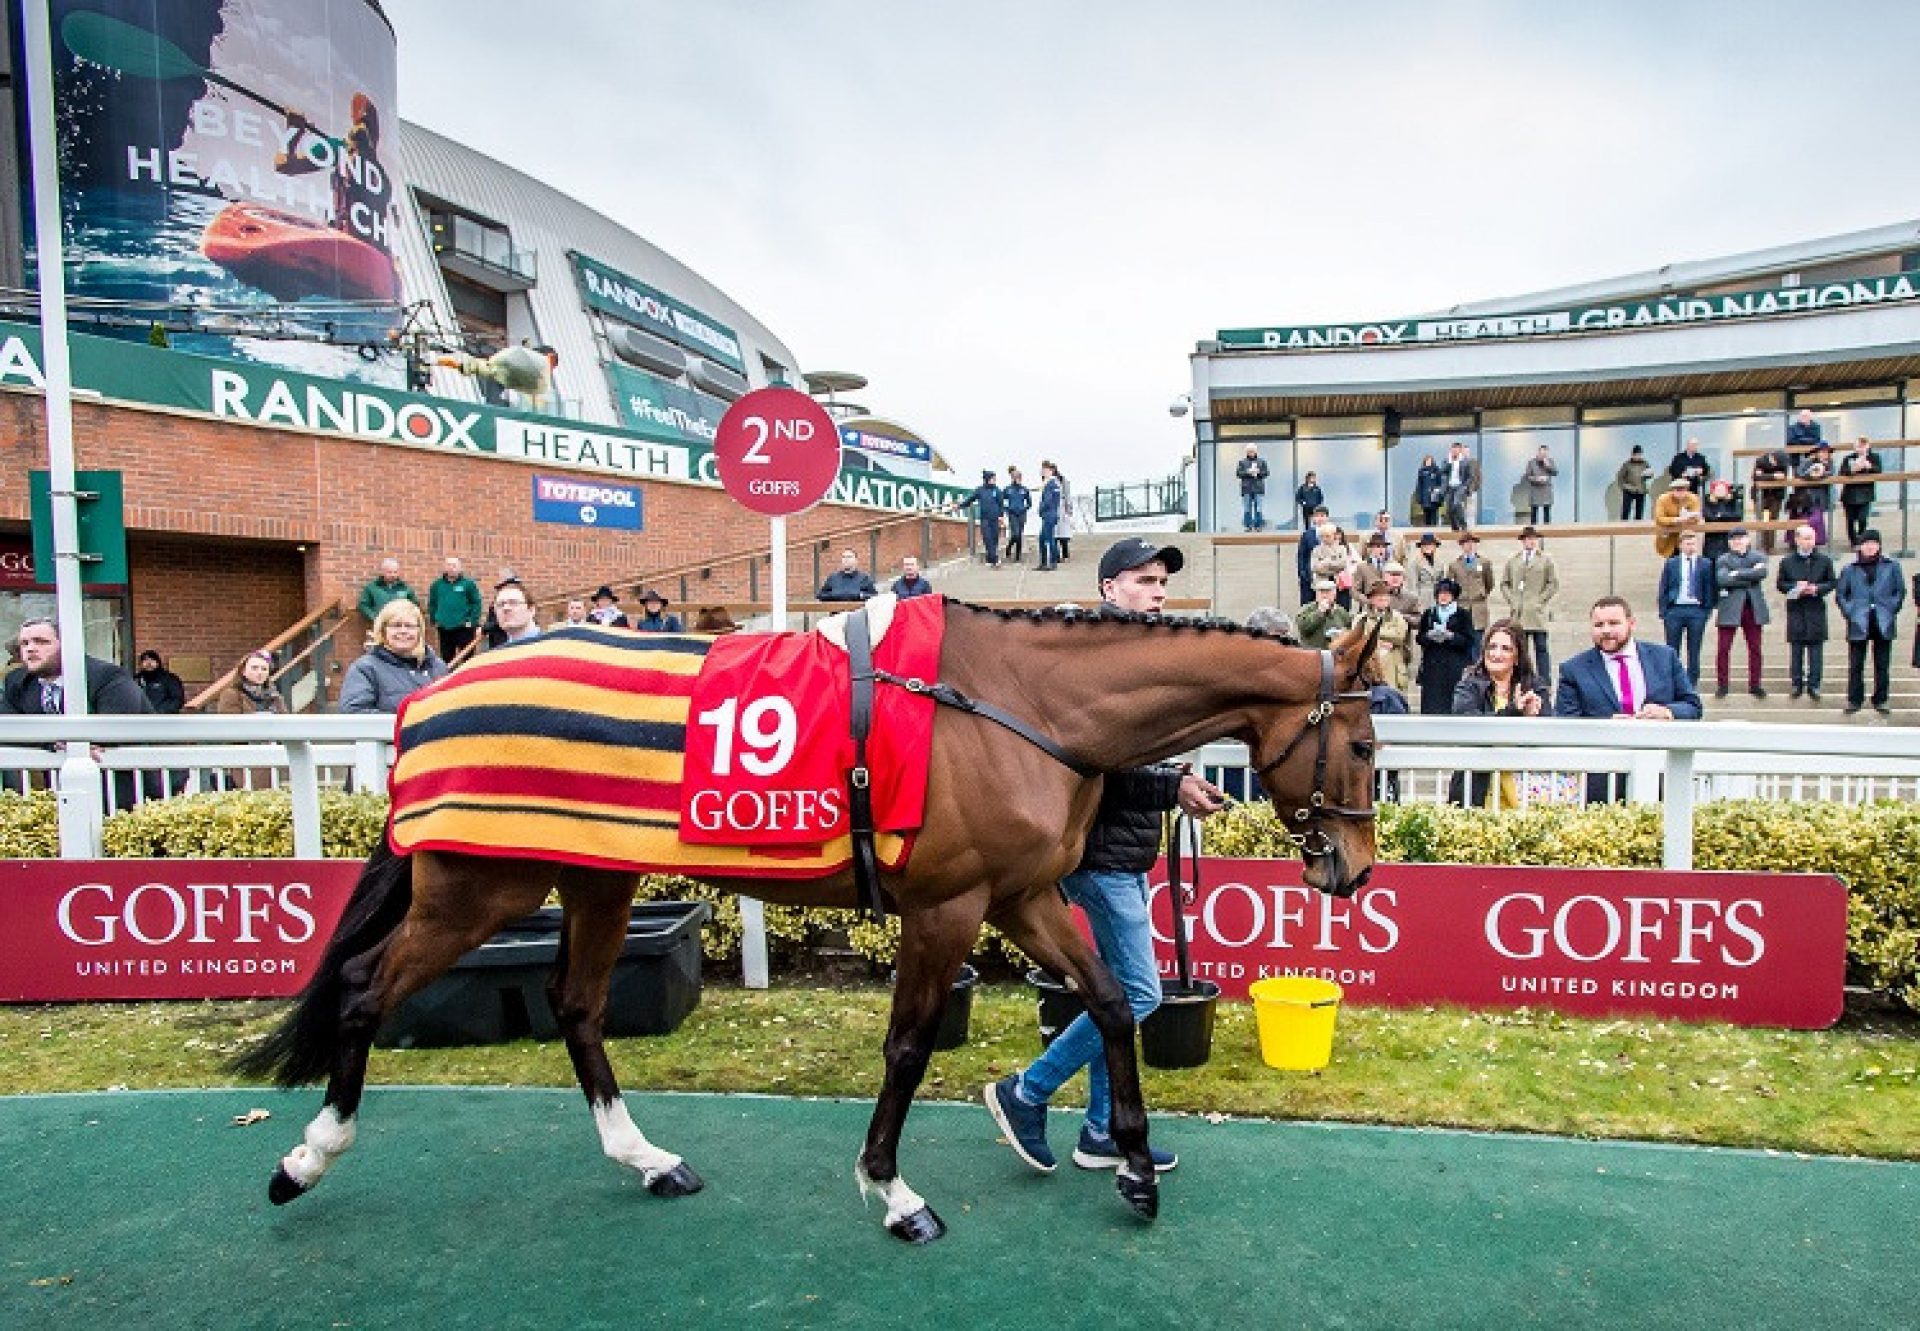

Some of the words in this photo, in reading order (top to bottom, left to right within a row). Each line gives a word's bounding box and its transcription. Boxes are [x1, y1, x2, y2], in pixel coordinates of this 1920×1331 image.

[193, 99, 383, 195] BEYOND
[128, 144, 336, 221] HEALTH
[584, 267, 675, 328] RANDOX
[1264, 322, 1408, 349] RANDOX
[1435, 317, 1551, 339] HEALTH
[1579, 301, 1712, 329] GRAND
[211, 368, 482, 451] RANDOX
[522, 428, 669, 475] HEALTH
[541, 480, 636, 508] TOTEPOOL
[749, 480, 800, 496] GOFFS
[698, 695, 798, 777] 19
[690, 788, 841, 830] GOFFS
[57, 882, 317, 945] GOFFS
[1148, 882, 1401, 953] GOFFS
[1484, 892, 1766, 967] GOFFS
[76, 959, 169, 976] UNITED
[181, 959, 297, 974] KINGDOM
[1502, 975, 1599, 995] UNITED
[1612, 979, 1740, 1000] KINGDOM
